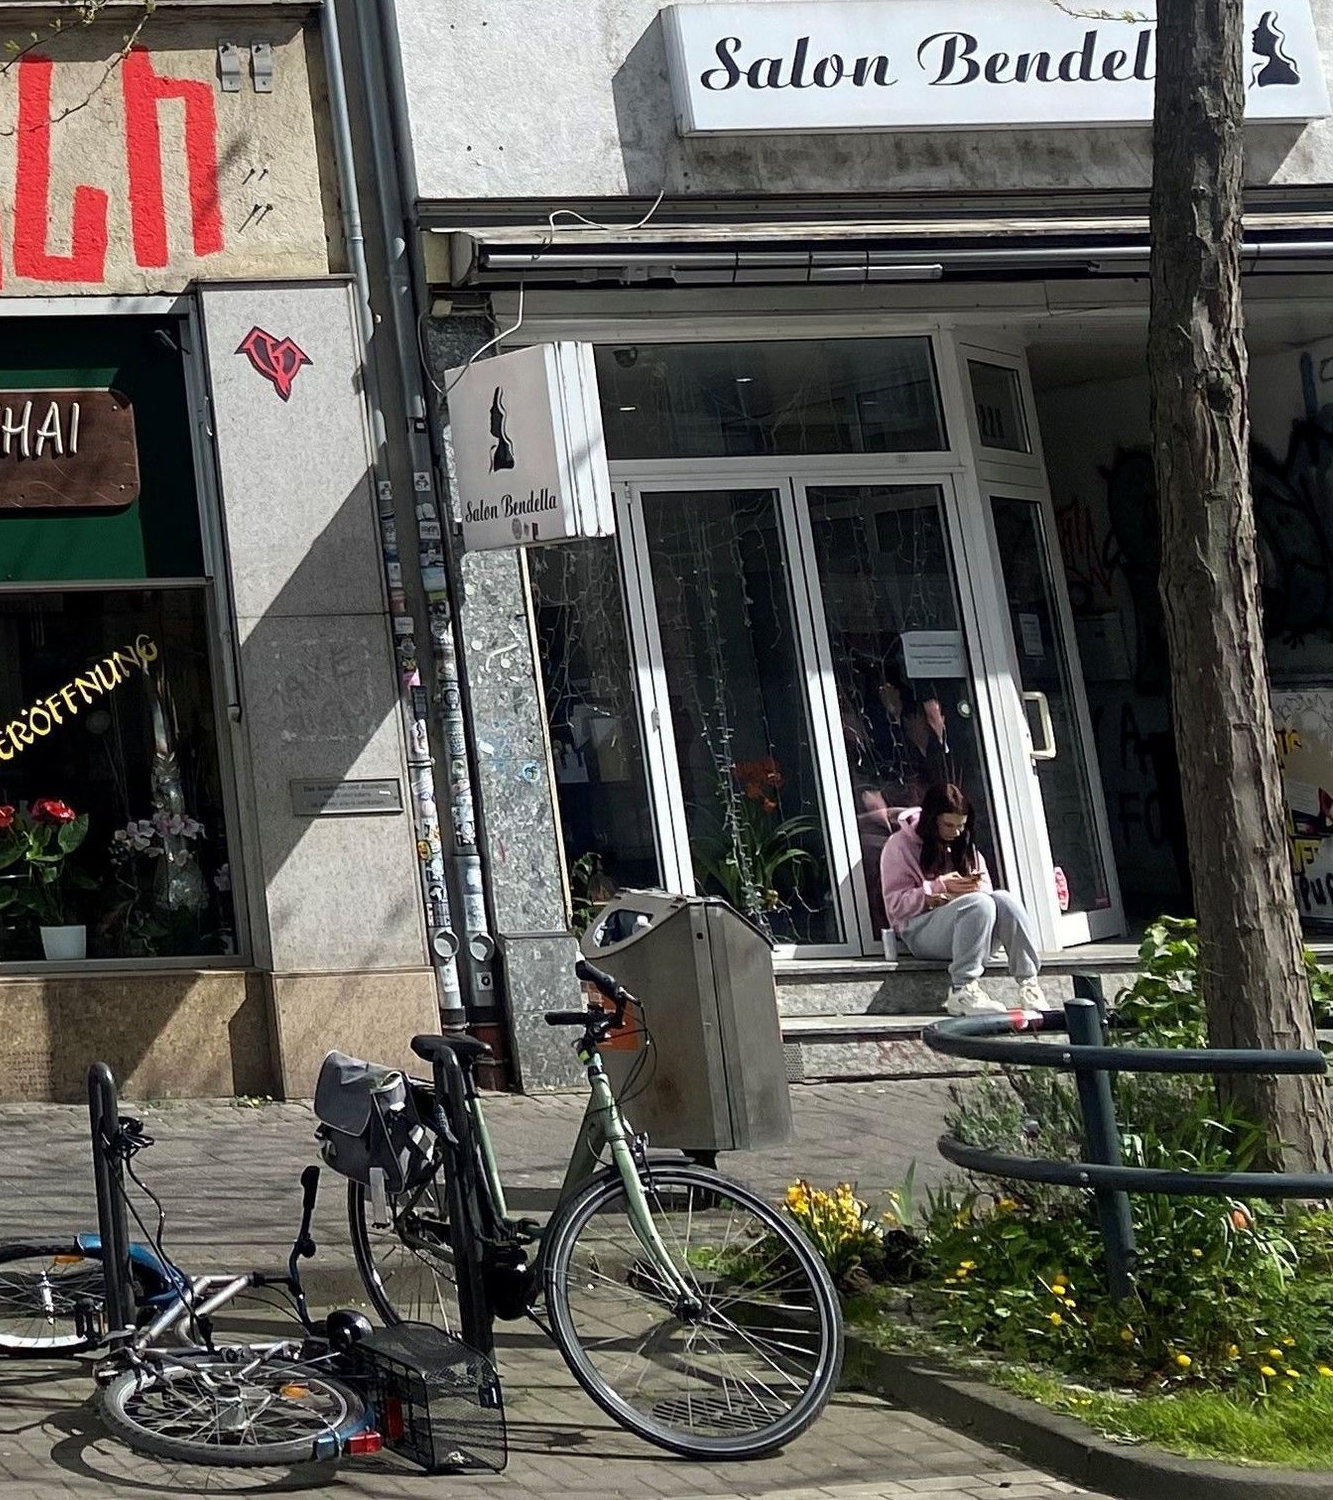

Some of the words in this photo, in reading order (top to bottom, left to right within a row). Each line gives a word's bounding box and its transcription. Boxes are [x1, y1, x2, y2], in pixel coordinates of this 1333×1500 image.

[700, 35, 899, 92] Salon
[916, 27, 1158, 87] Bendel
[465, 499, 499, 523] Salon
[501, 488, 558, 518] Bendella
